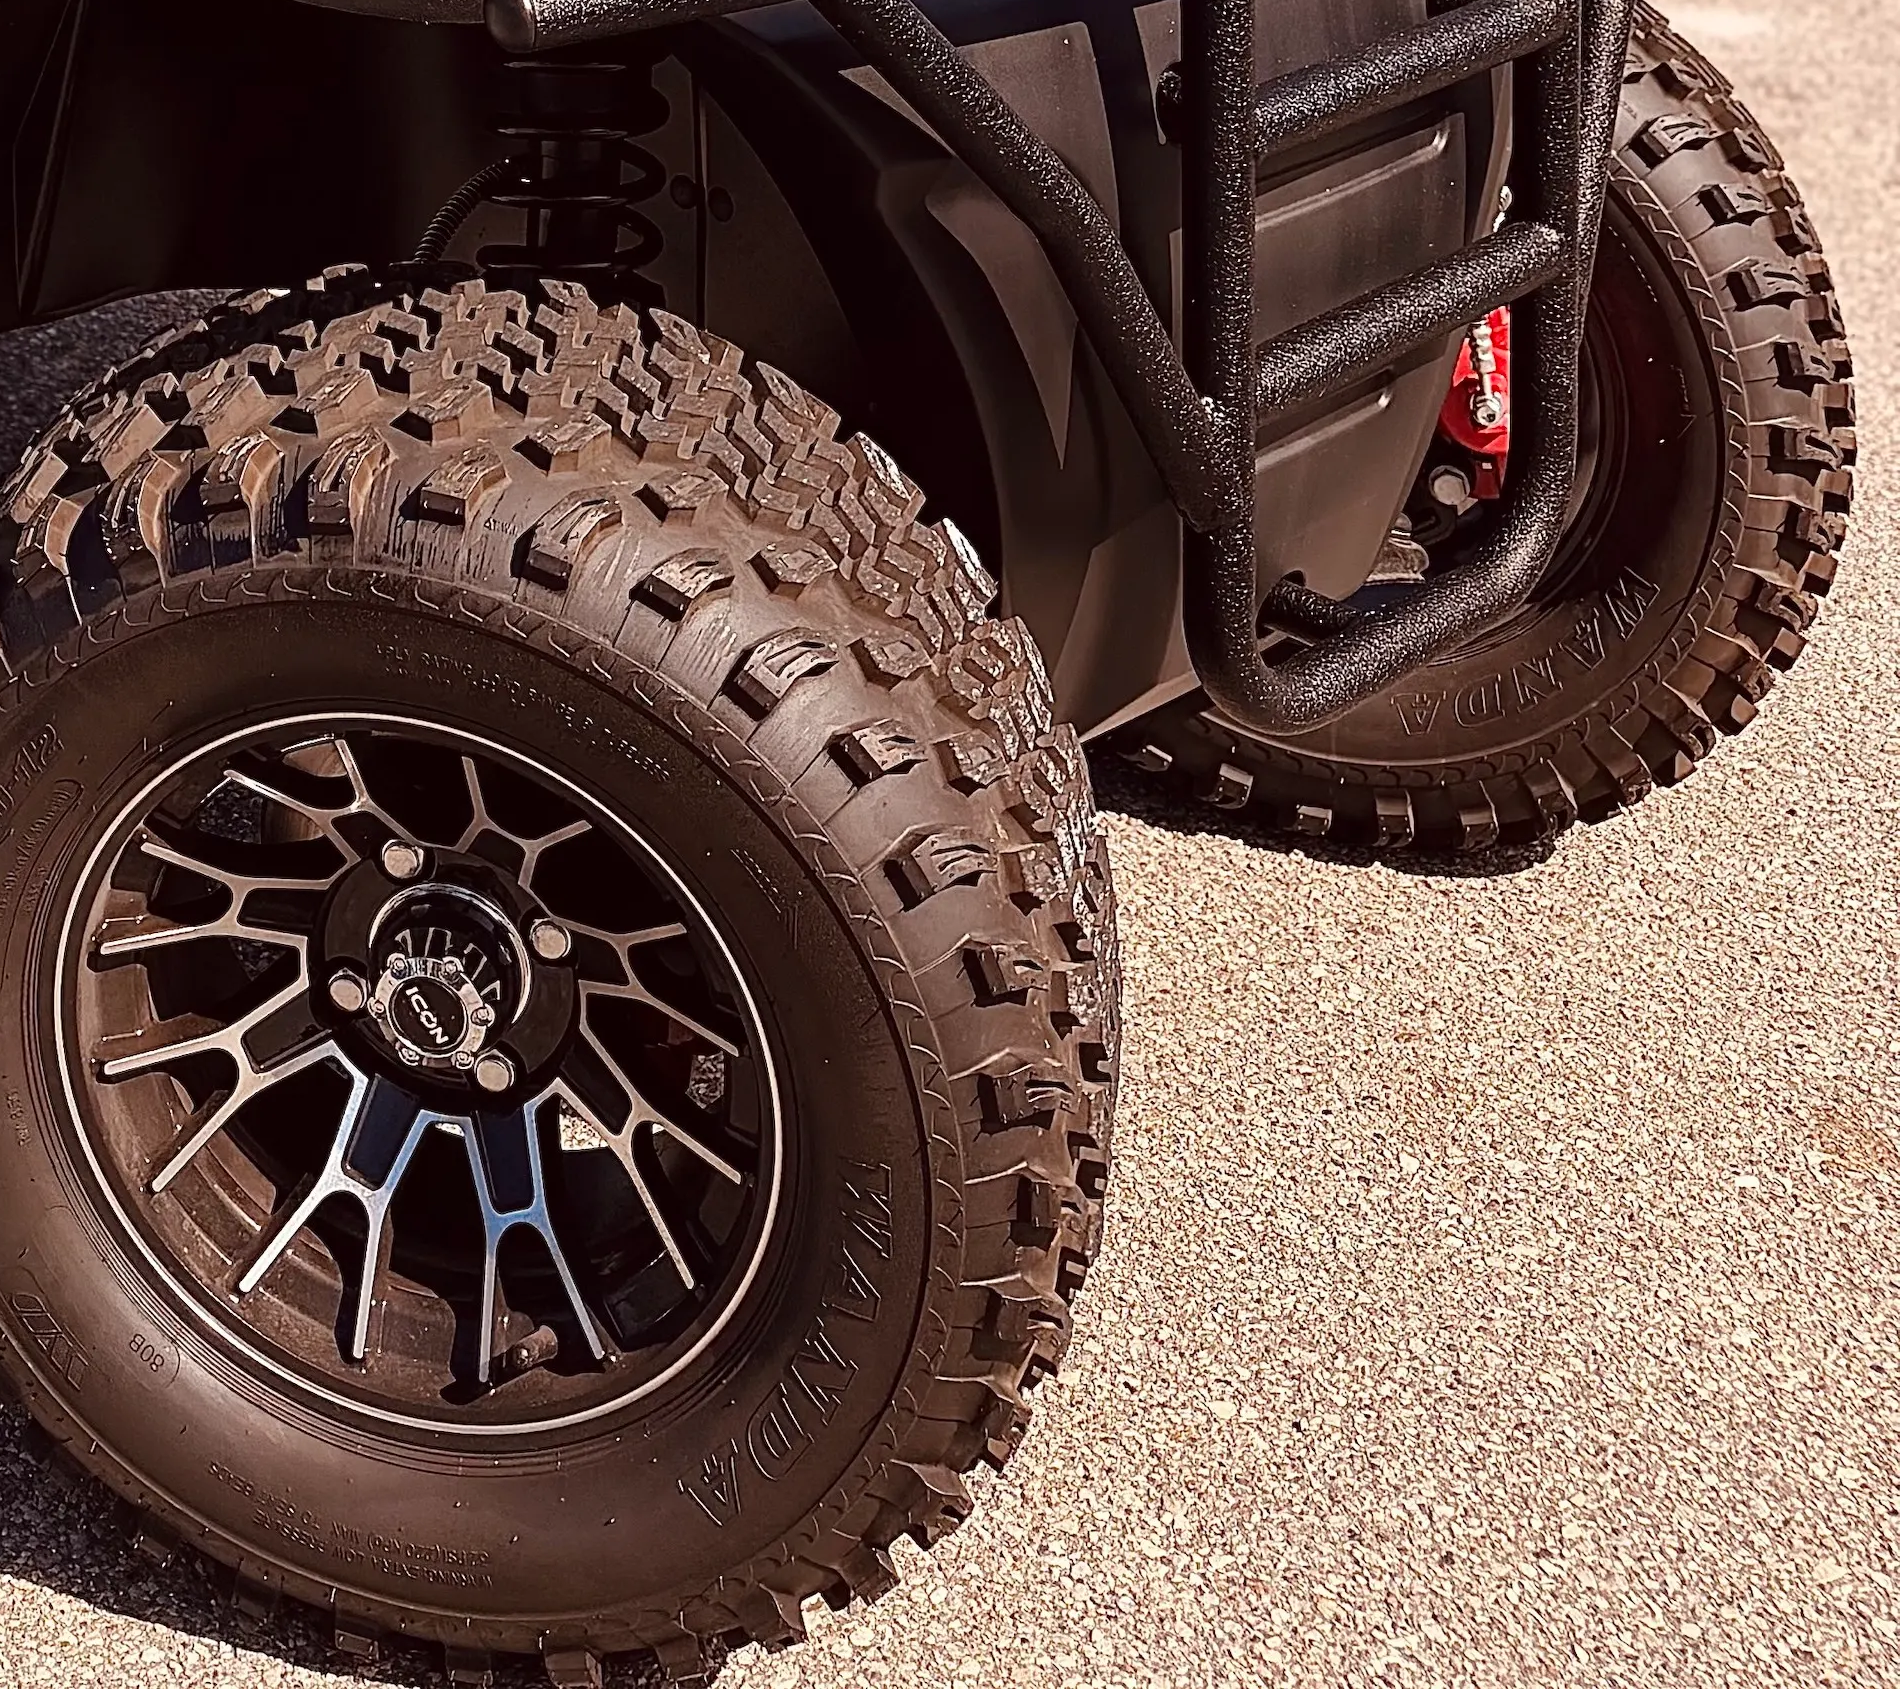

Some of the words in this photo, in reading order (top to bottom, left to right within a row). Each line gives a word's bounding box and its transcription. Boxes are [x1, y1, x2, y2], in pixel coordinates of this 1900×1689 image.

[1390, 565, 1661, 737] WANDA
[405, 986, 449, 1044] ICON
[676, 1154, 893, 1527] WANDA
